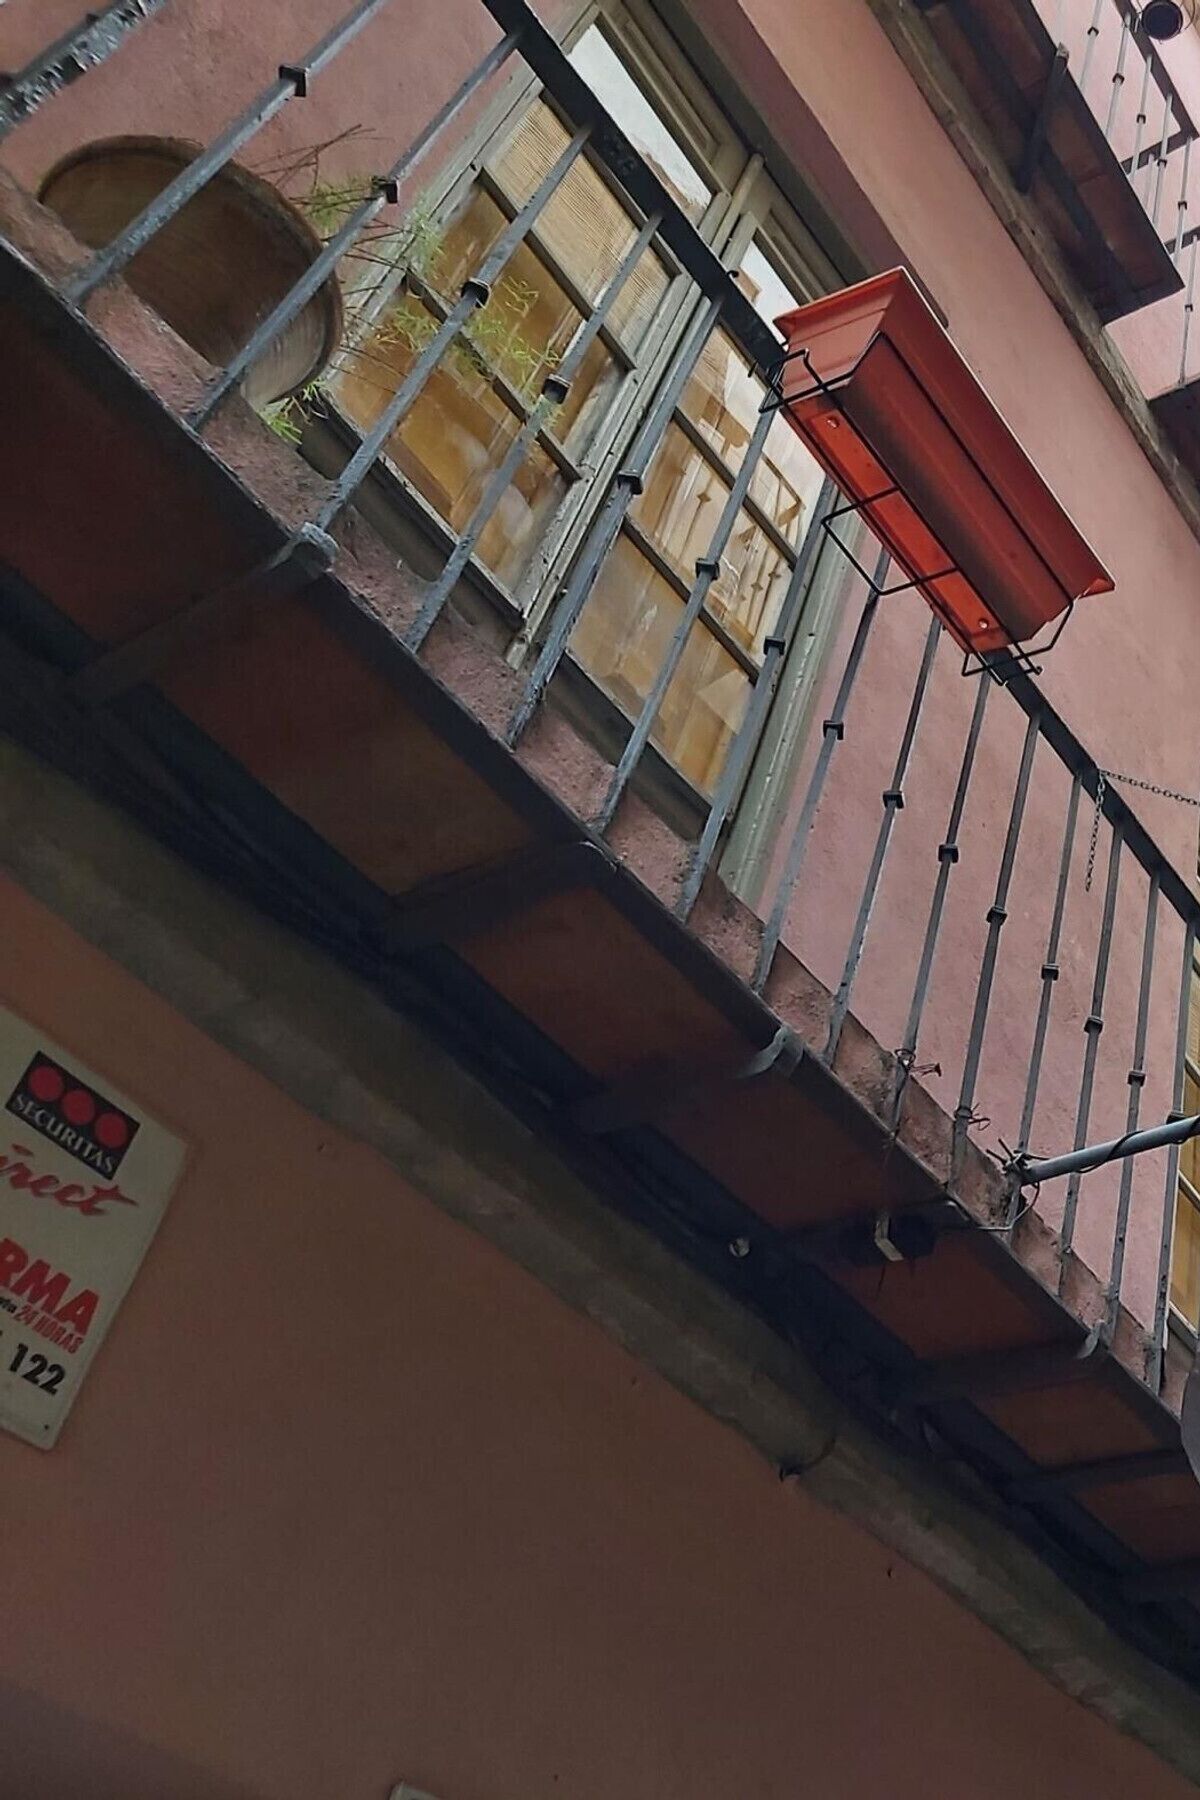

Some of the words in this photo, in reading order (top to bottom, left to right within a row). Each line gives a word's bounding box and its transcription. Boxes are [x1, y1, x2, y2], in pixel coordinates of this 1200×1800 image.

[14, 1093, 114, 1173] SECURITAS
[13, 1303, 39, 1327] 24
[32, 1314, 85, 1355] HORAS
[8, 1342, 66, 1396] 122
